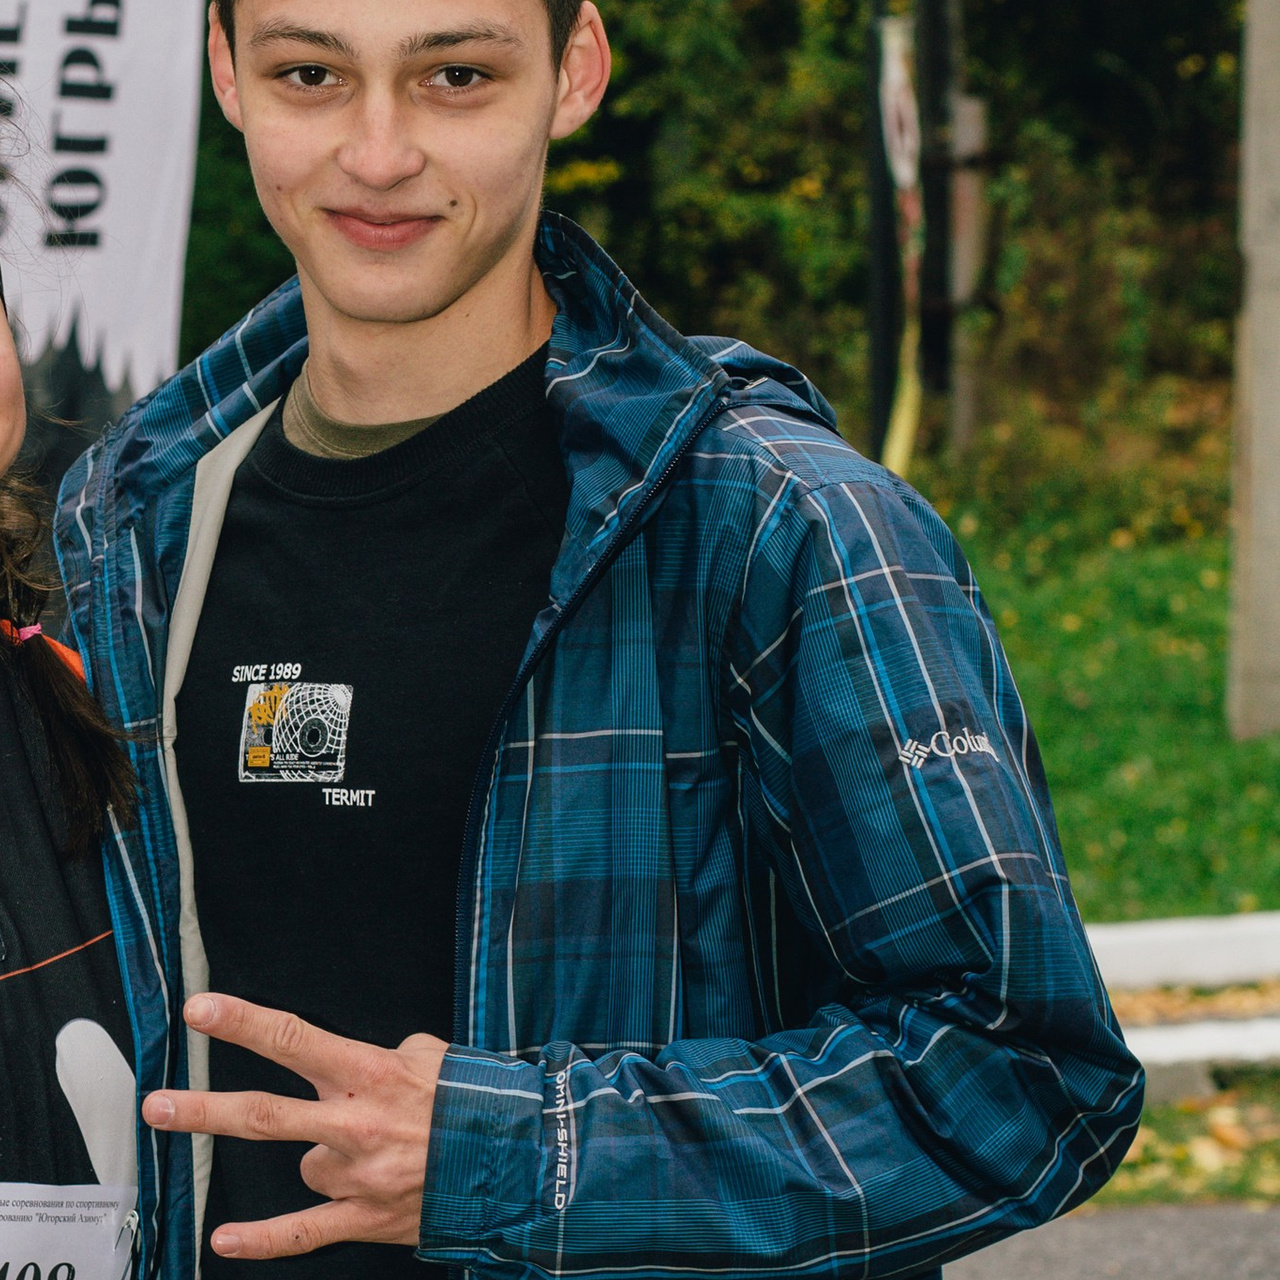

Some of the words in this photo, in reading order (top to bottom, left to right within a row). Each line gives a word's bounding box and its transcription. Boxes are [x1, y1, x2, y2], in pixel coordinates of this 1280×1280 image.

[231, 664, 268, 682] SINCE
[269, 662, 302, 680] 1989
[322, 788, 376, 807] TERMIT
[553, 1071, 568, 1211] OMNI-SHIELD
[11, 1199, 64, 1210] соревнования
[65, 1200, 75, 1208] по
[75, 1200, 119, 1211] спортивному
